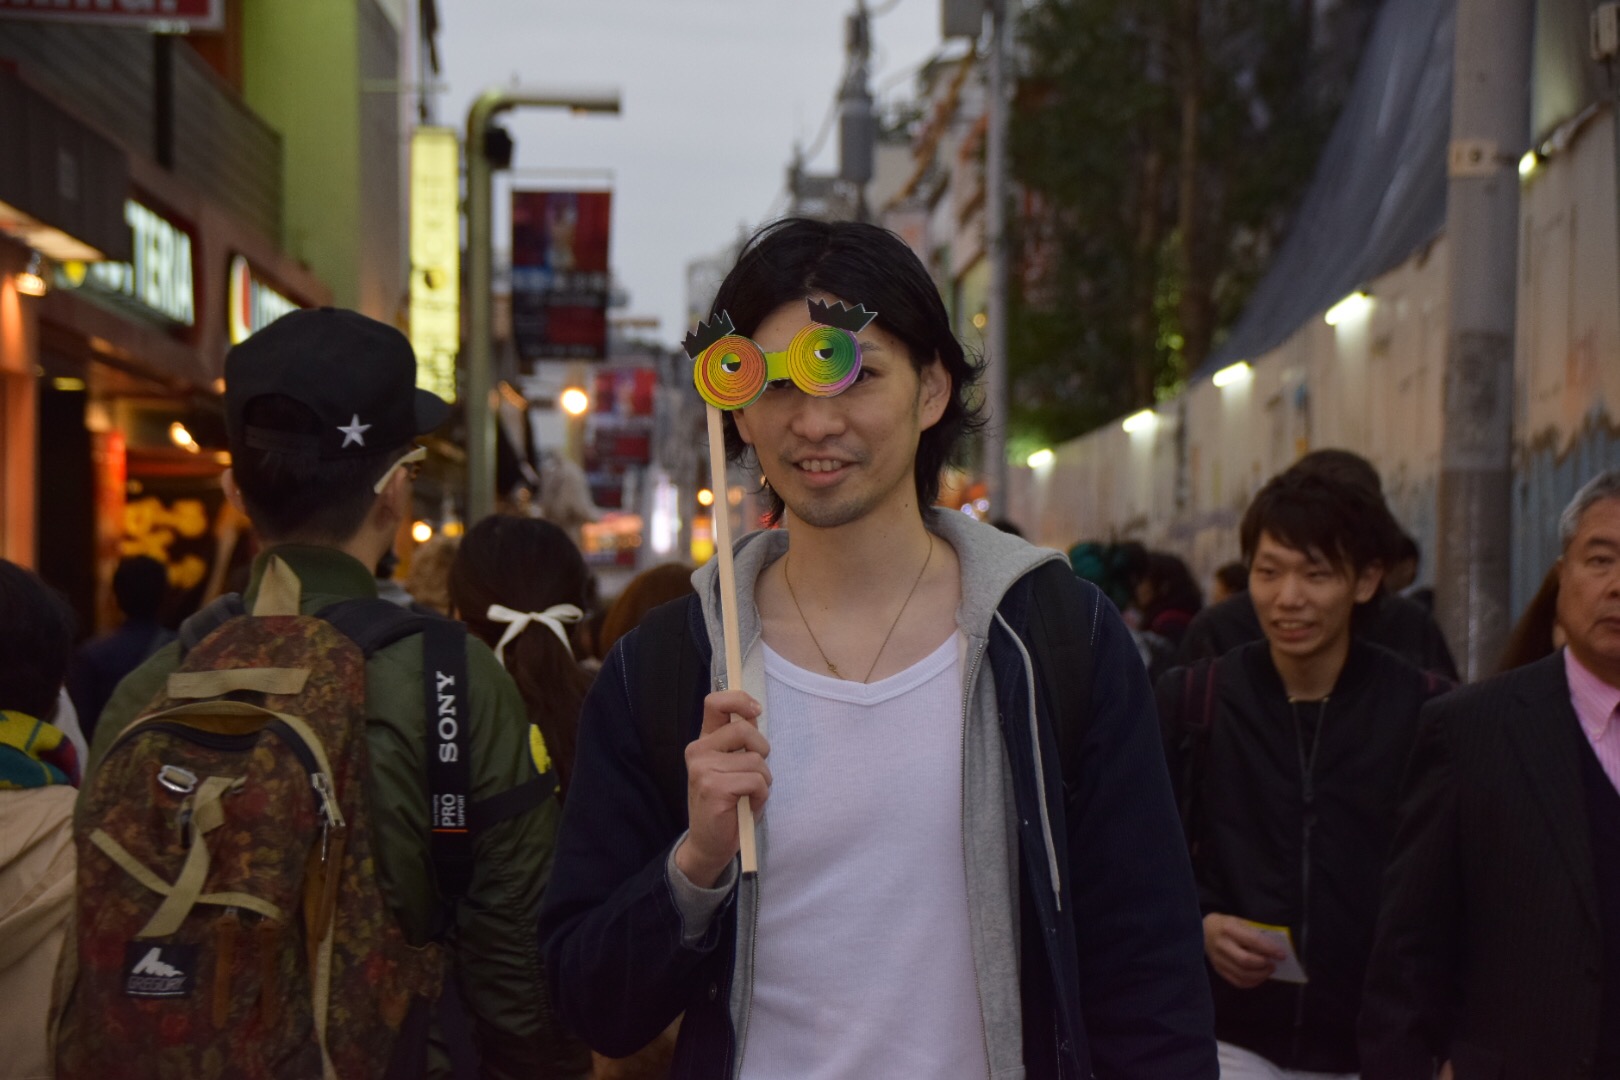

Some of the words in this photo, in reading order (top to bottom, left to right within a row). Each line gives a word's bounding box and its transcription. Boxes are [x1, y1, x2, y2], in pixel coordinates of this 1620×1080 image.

[436, 671, 458, 762] SONY
[440, 793, 456, 827] PRO
[457, 794, 465, 827] SUPPORT
